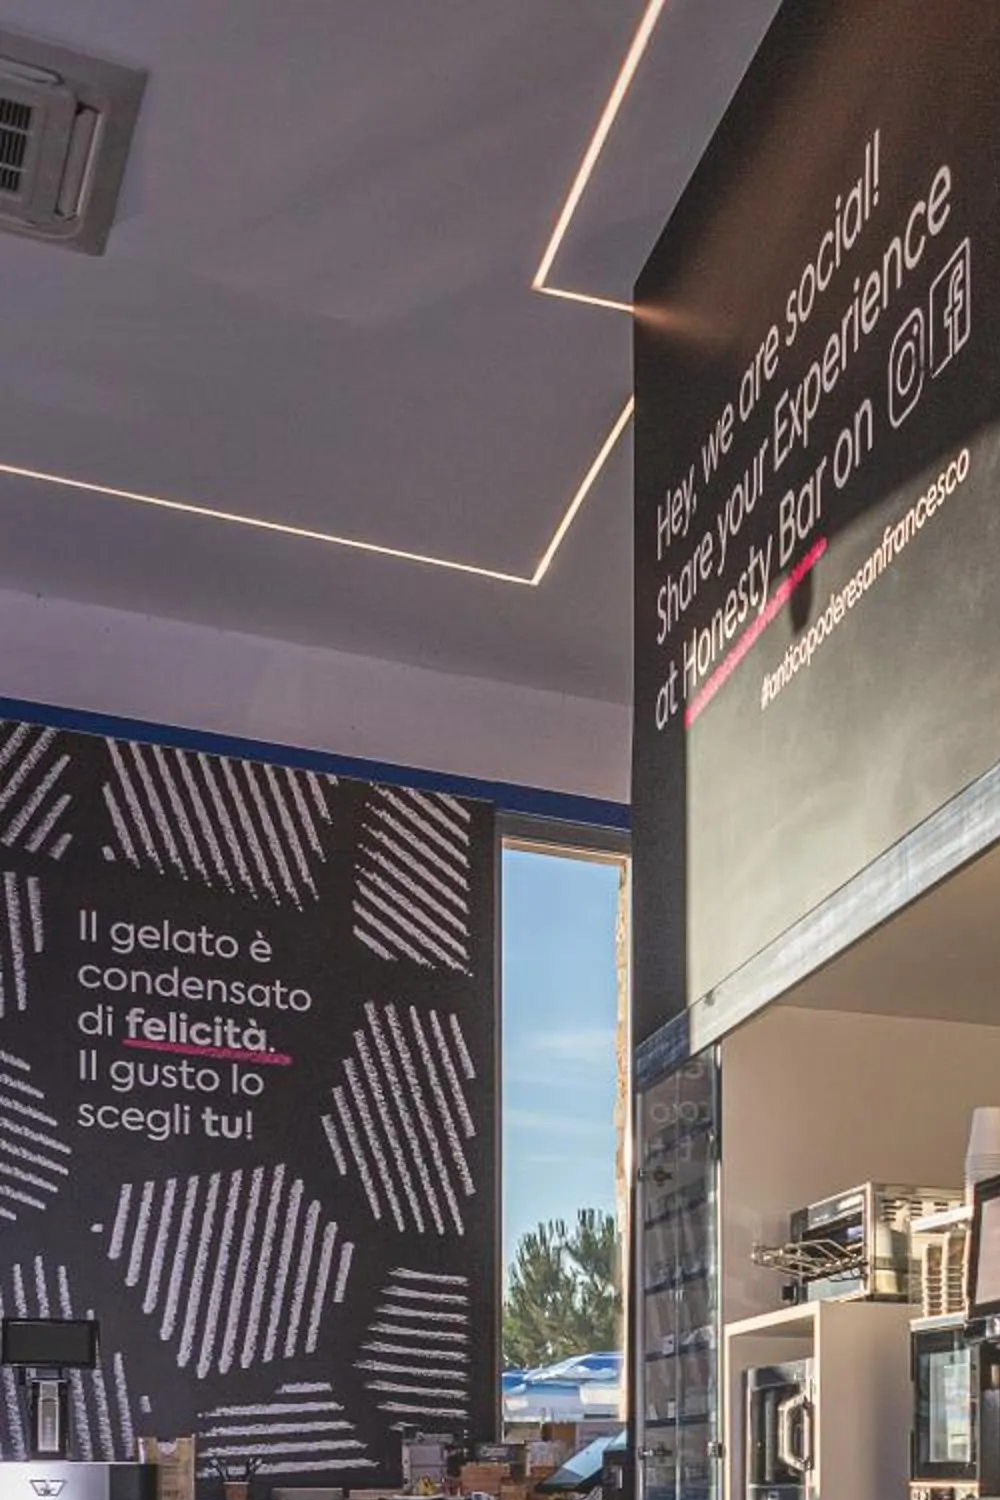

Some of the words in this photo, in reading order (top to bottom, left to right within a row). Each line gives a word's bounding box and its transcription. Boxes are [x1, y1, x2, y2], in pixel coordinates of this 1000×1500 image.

[657, 463, 698, 561] Hey,
[702, 401, 734, 485] we
[739, 324, 780, 423] are
[785, 127, 881, 347] social!
[656, 531, 714, 646] Share
[717, 437, 769, 577] your
[774, 164, 952, 473] Experience
[655, 659, 679, 731] at
[683, 532, 774, 700] Honesty
[779, 455, 828, 569] Bar
[833, 397, 874, 490] on
[760, 447, 971, 711] #anticopoderesanfrancesco
[79, 909, 98, 942] Il
[109, 919, 240, 959] gelato
[249, 930, 273, 962] è
[77, 963, 312, 1012] condensato
[77, 1003, 114, 1036] di
[126, 1007, 276, 1053] felicità.
[79, 1049, 98, 1081] Il
[109, 1059, 220, 1092] gusto
[231, 1063, 265, 1096] lo
[76, 1102, 192, 1140] scegli
[201, 1106, 254, 1140] tu!
